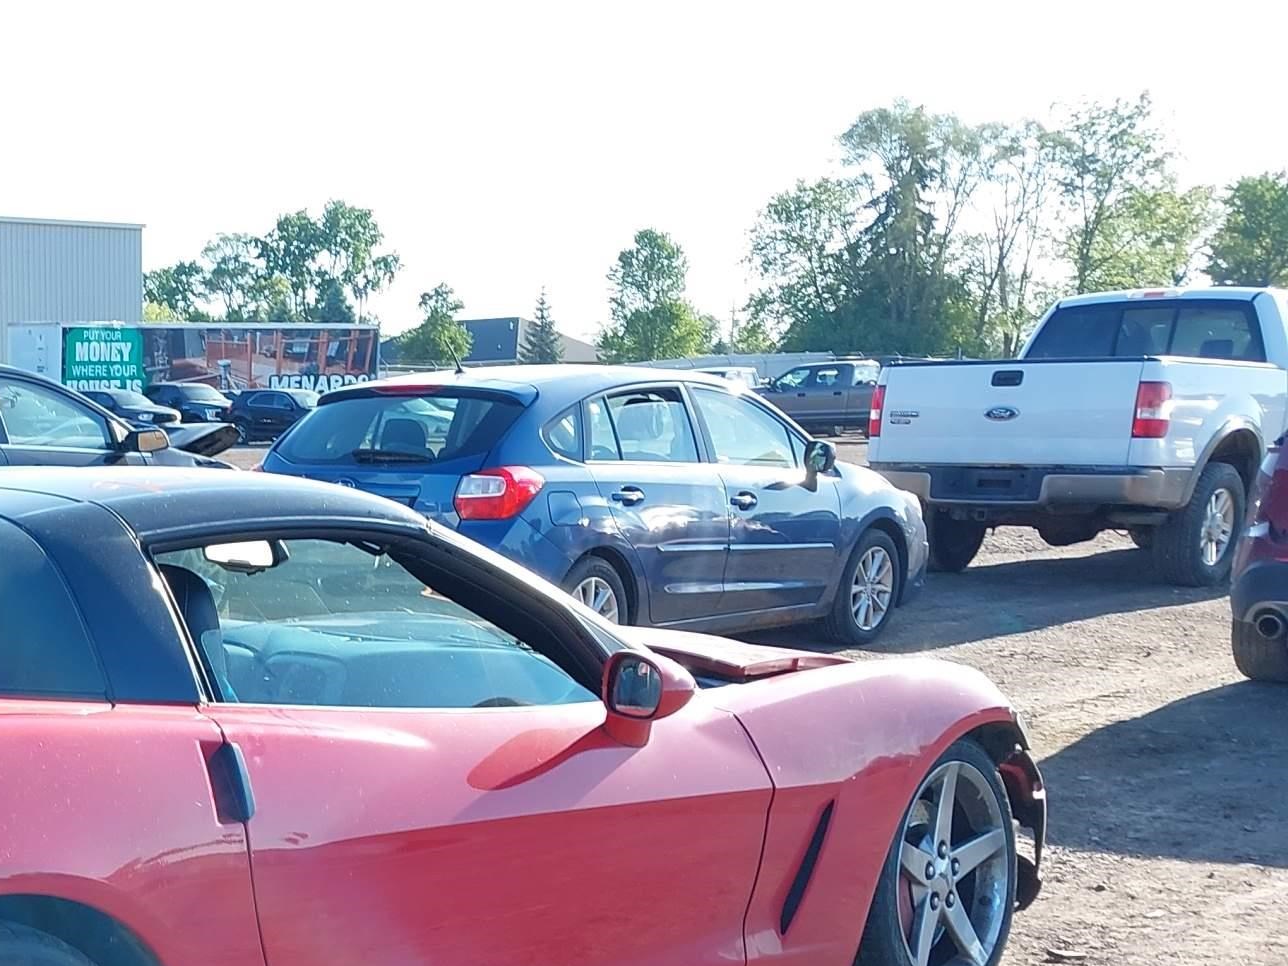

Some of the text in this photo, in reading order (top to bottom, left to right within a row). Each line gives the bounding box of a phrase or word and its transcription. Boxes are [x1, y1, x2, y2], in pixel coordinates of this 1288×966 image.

[83, 330, 122, 341] PUT YOUR
[75, 341, 132, 362] MONEY
[71, 365, 138, 377] WHERE YOUR
